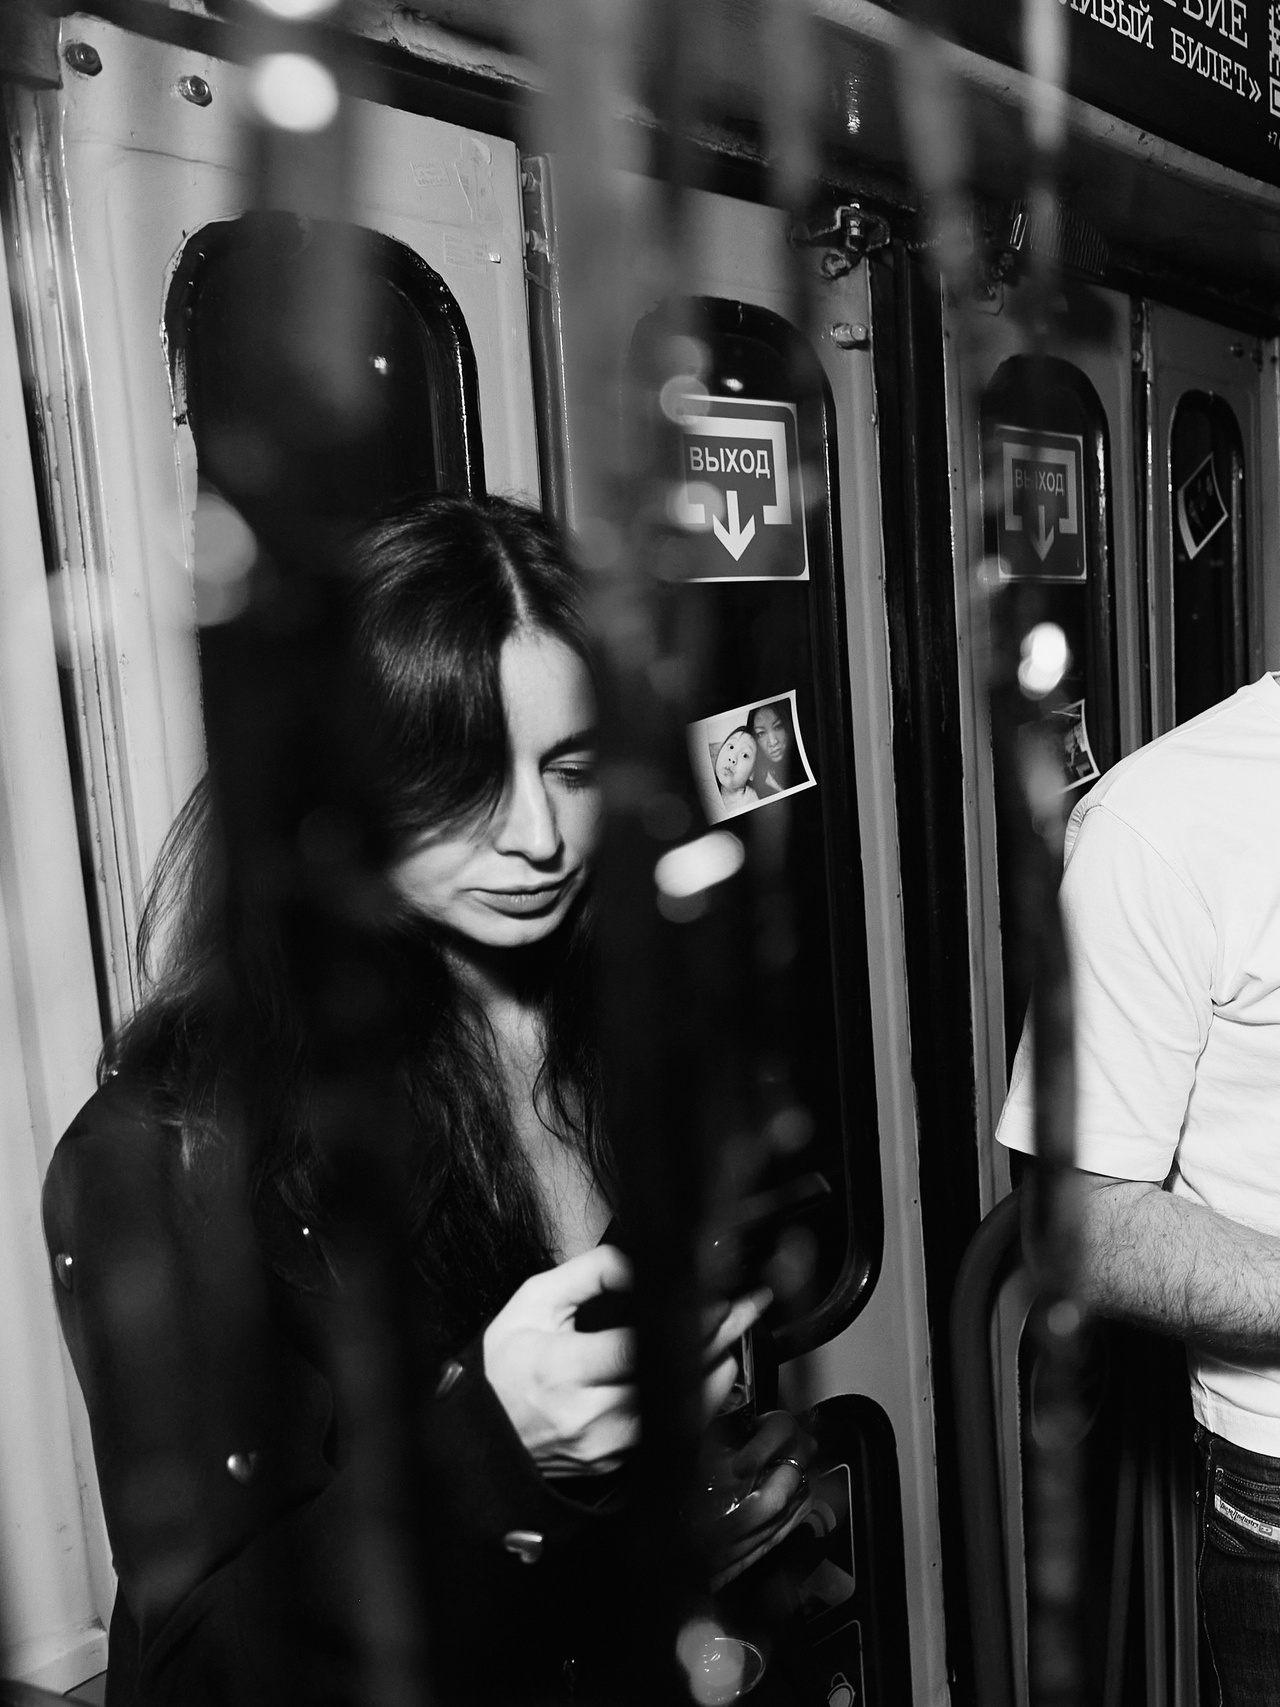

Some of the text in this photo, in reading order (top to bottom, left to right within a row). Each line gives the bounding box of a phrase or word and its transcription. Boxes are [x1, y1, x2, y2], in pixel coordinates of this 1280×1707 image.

[1060, 0, 1262, 103] ИВЫЙ БИЛЕТ»
[688, 446, 771, 480] ВЫХОД
[1014, 468, 1065, 497] ВЫХОД
